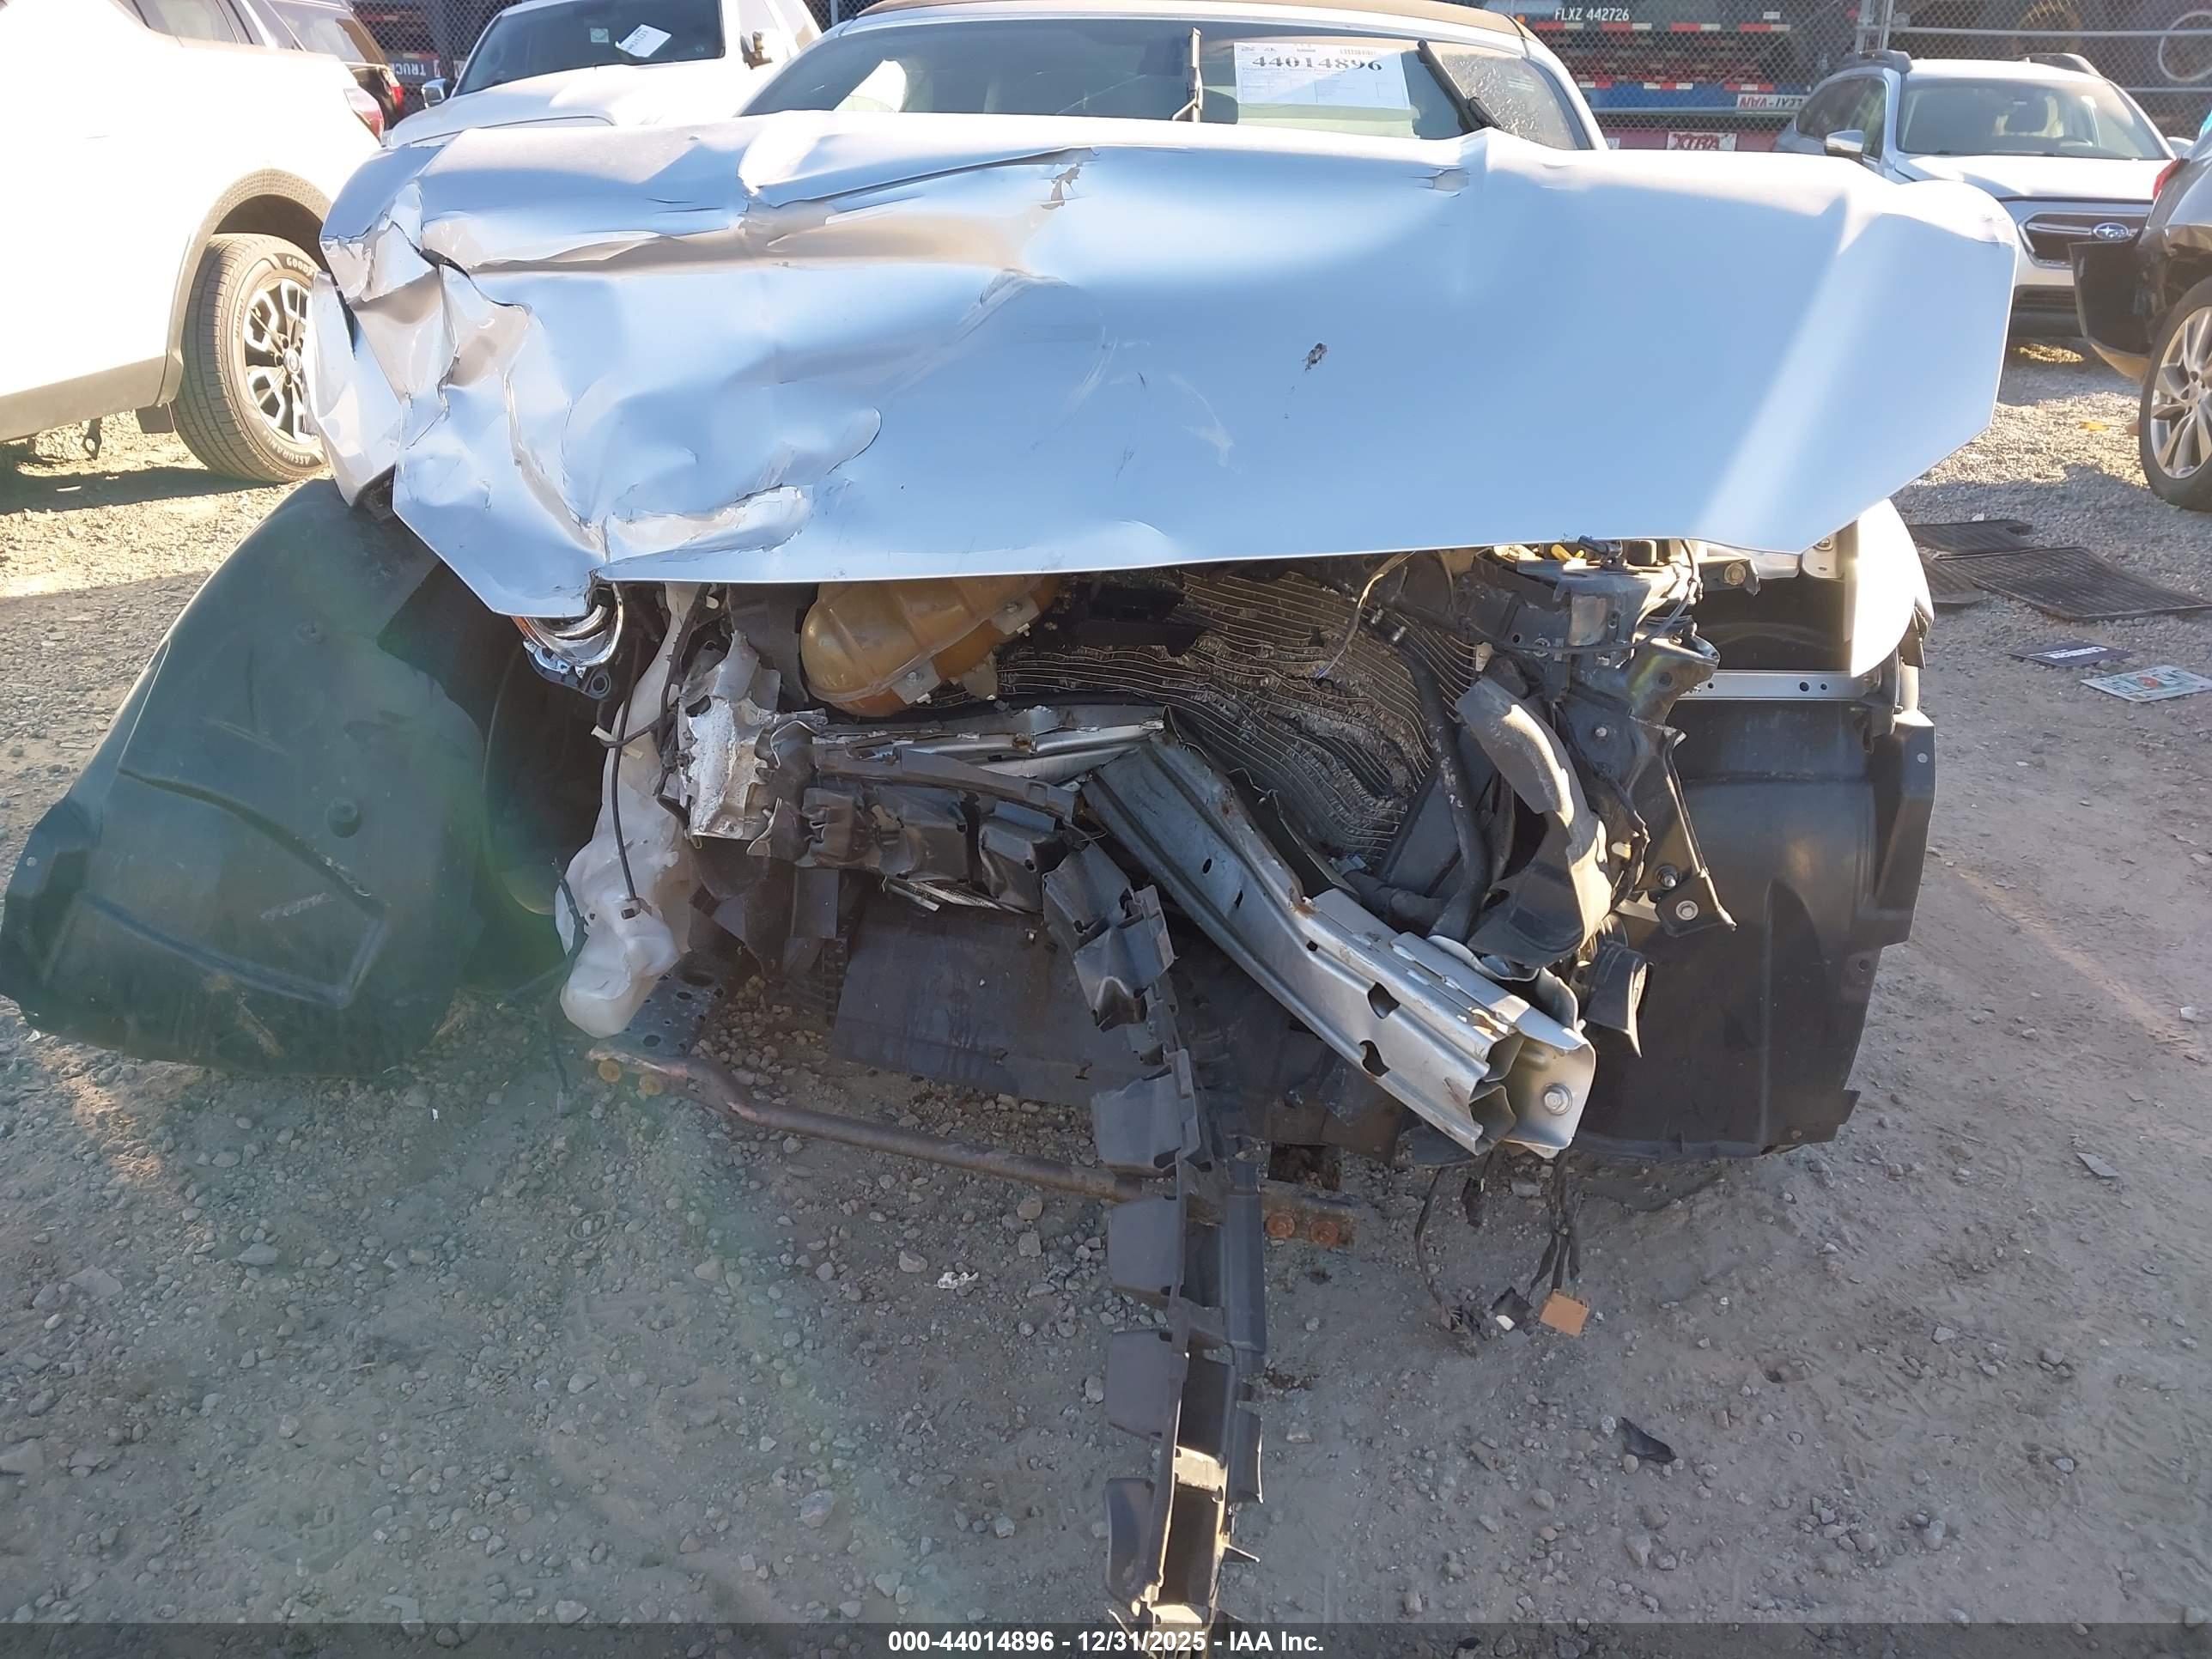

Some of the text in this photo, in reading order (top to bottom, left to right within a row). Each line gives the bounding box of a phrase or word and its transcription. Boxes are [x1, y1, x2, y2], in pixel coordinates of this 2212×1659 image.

[1554, 7, 1630, 21] FLXZ 442726
[1252, 56, 1382, 70] 44014896
